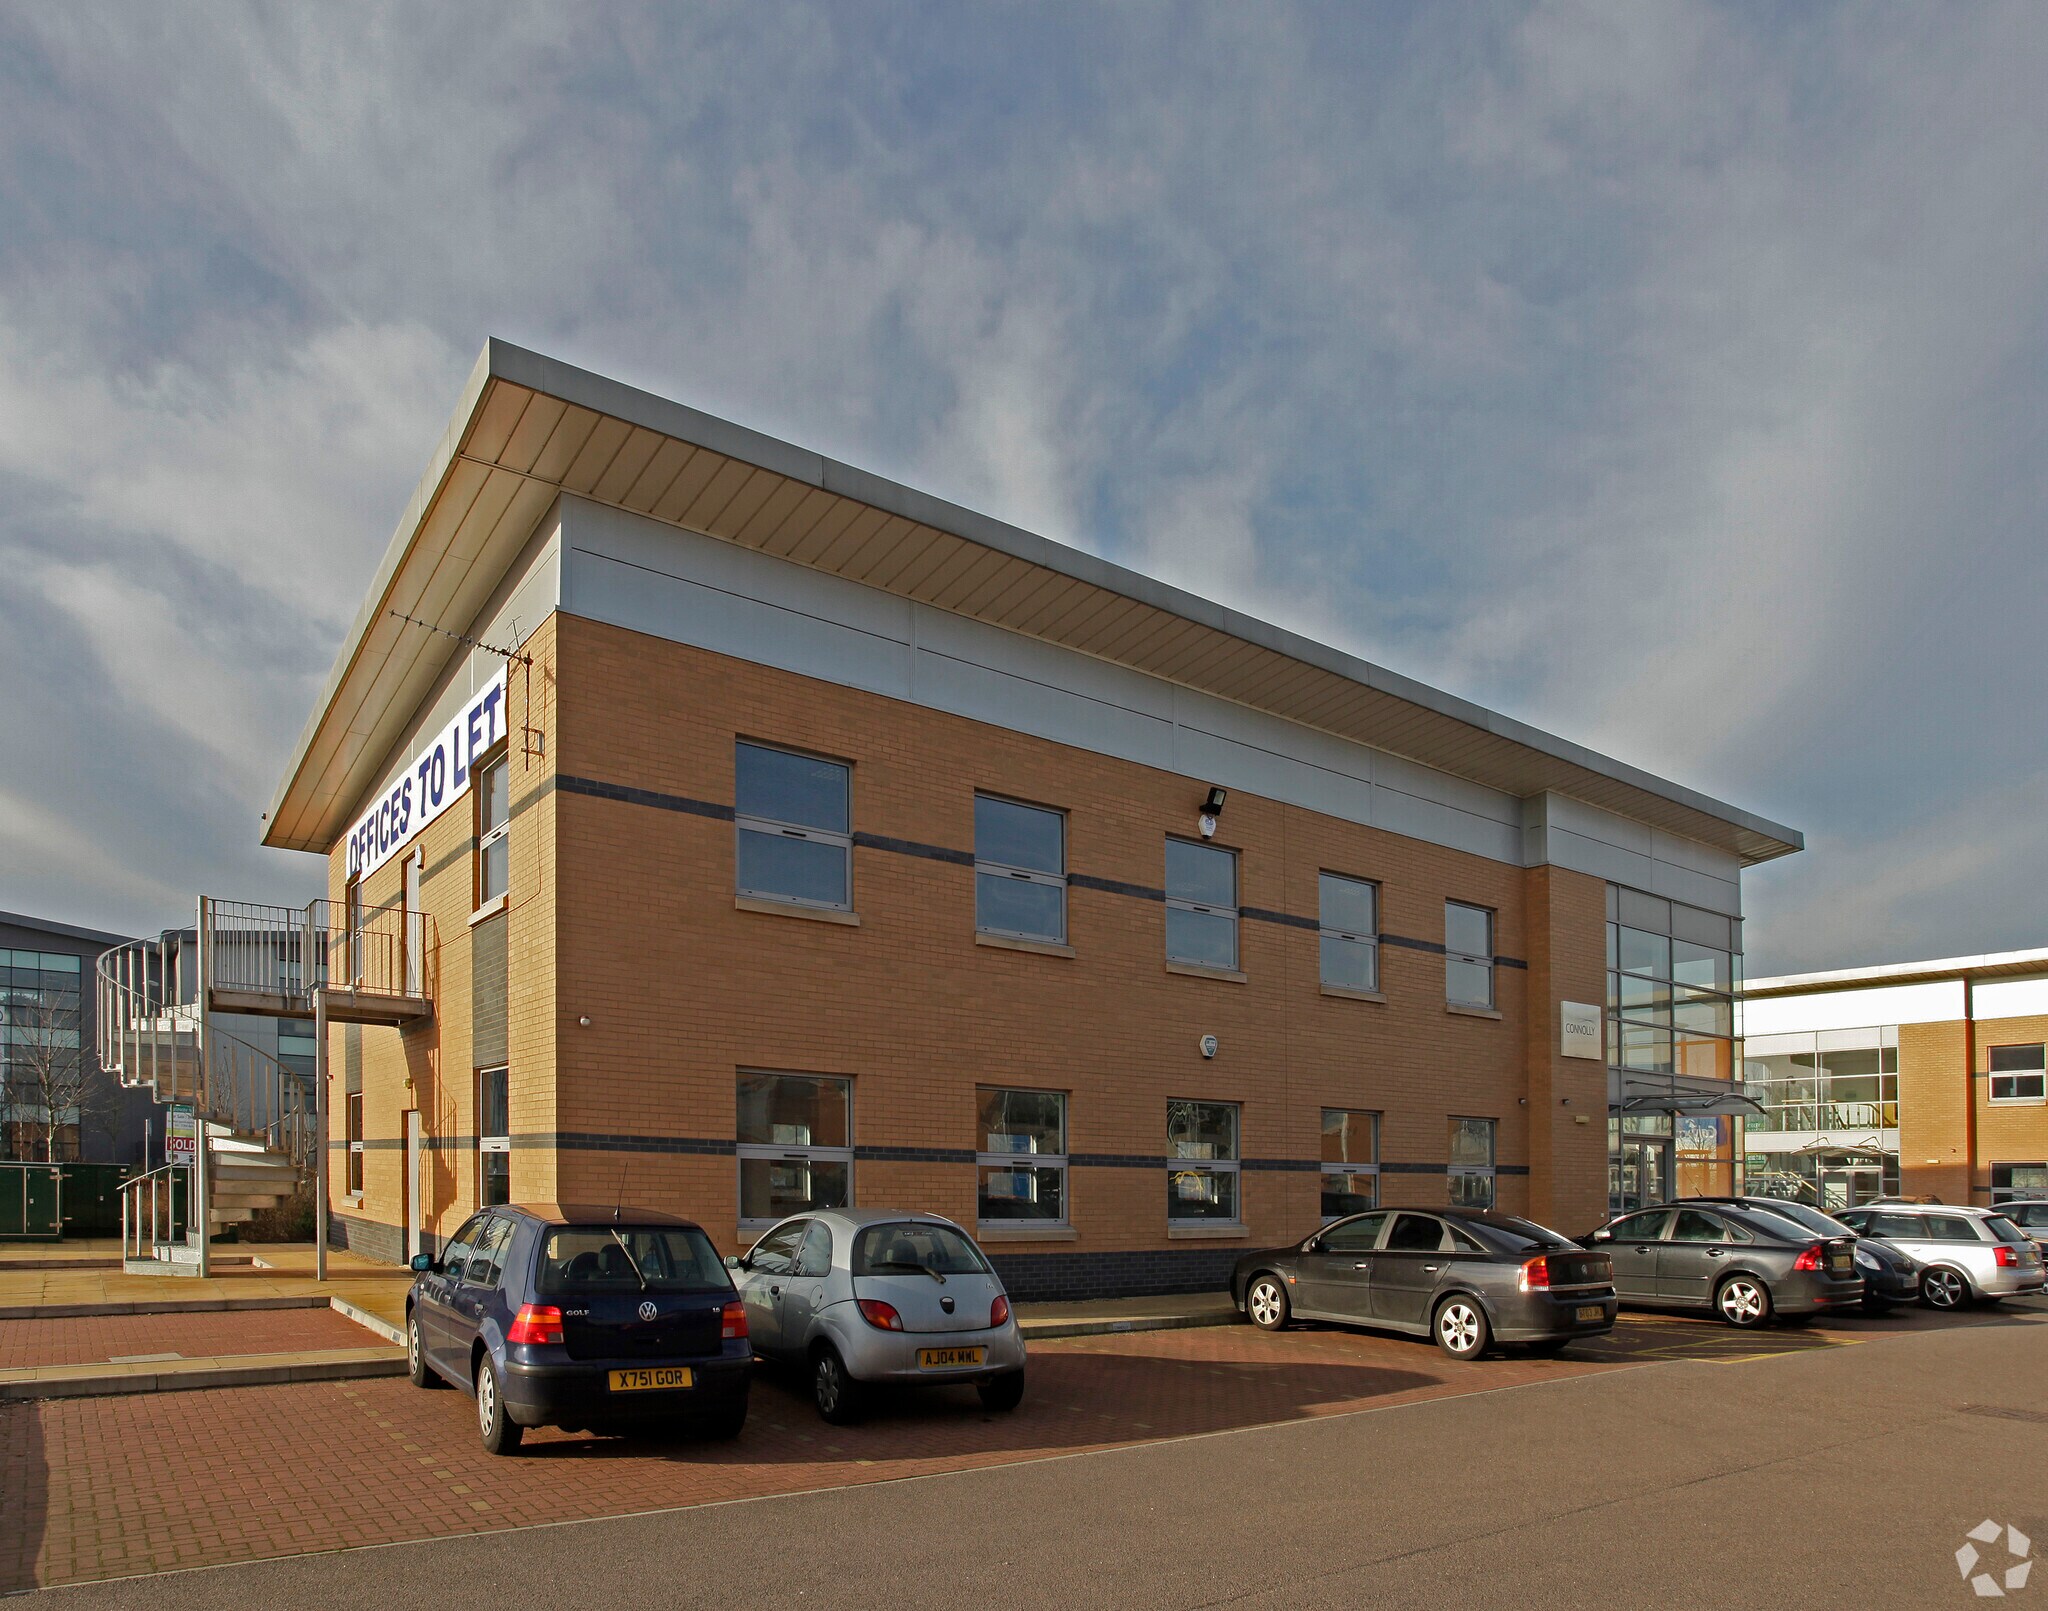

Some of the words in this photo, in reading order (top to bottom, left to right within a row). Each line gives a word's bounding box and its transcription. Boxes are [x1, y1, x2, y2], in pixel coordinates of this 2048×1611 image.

[350, 777, 412, 876] OFFICES
[418, 744, 445, 818] TO
[453, 683, 501, 790] LET
[1565, 1023, 1595, 1036] CONNOLLY
[170, 1138, 195, 1151] SOLD
[925, 1352, 955, 1365] AJ04
[619, 1371, 653, 1387] X751
[655, 1370, 683, 1386] GOR
